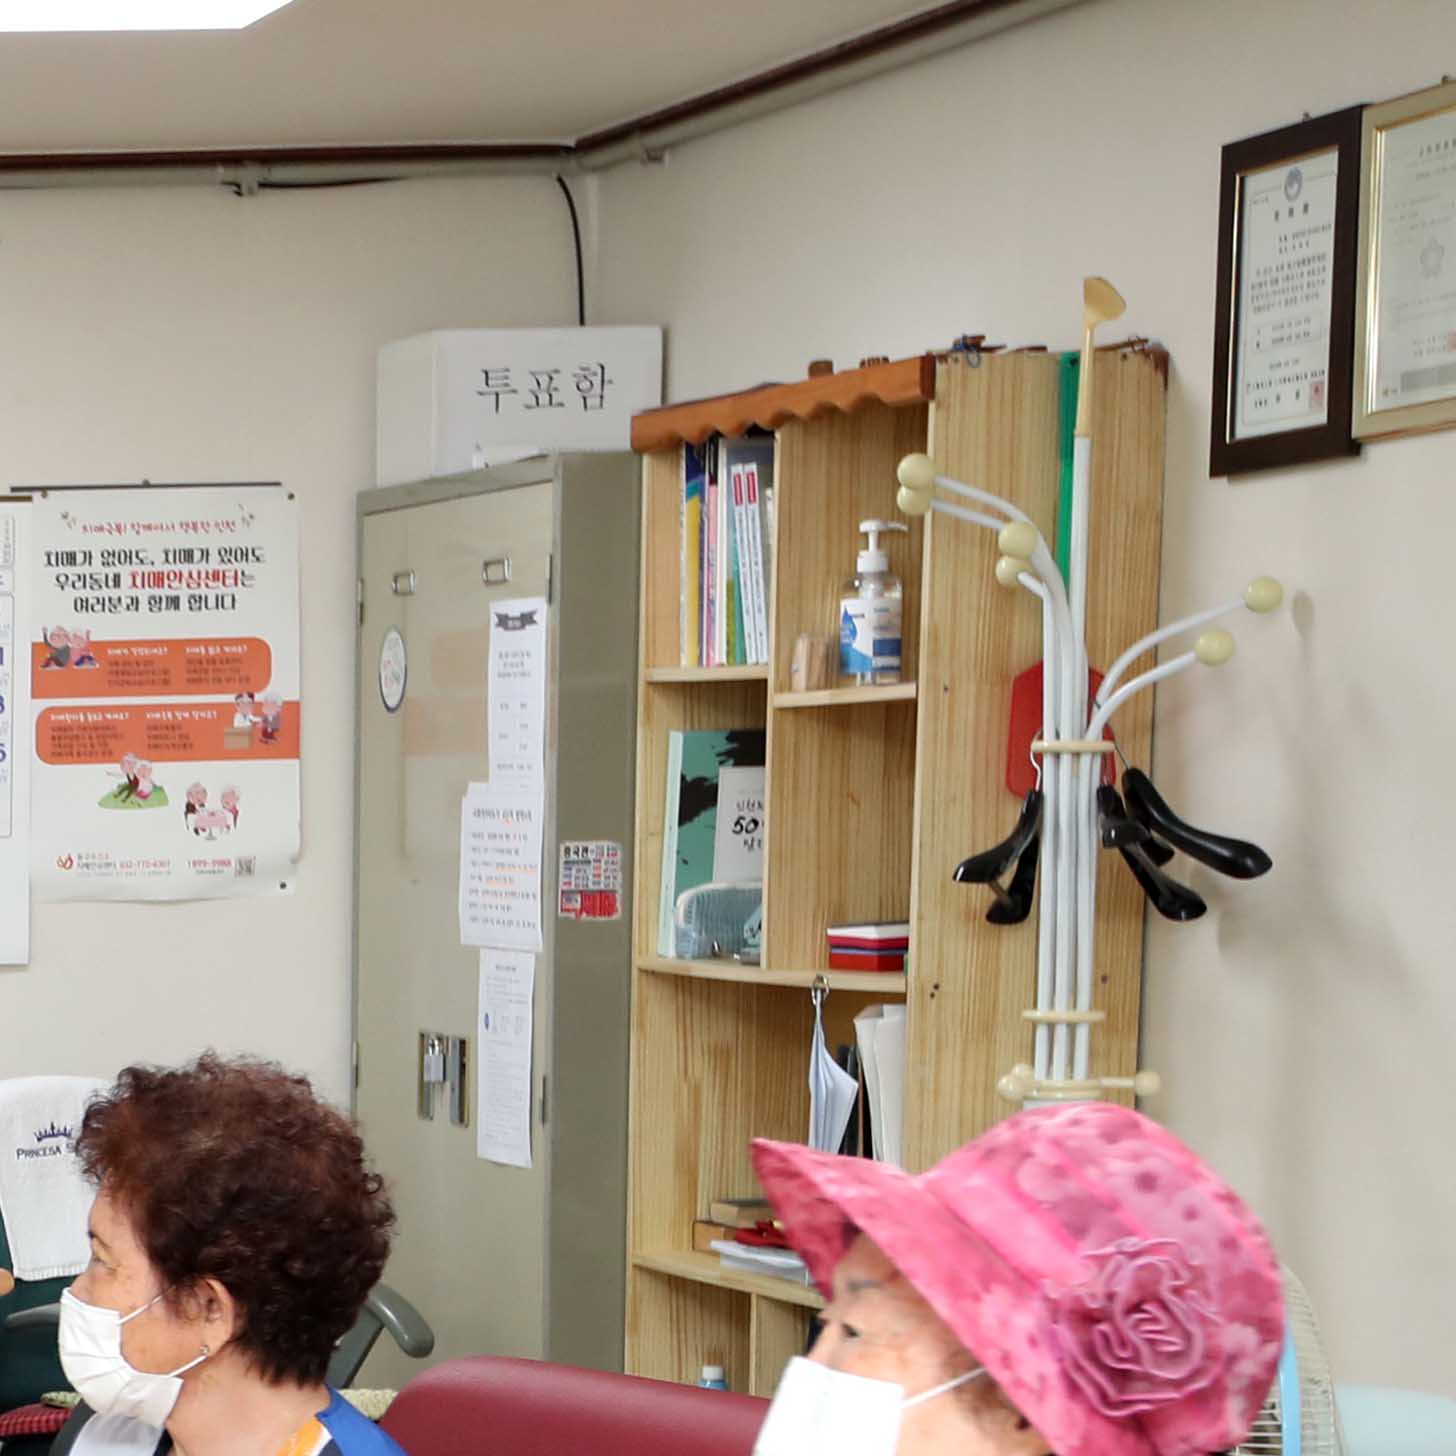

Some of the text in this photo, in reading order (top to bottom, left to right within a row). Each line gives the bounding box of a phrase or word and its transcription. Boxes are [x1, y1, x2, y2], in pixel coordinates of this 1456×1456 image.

[476, 361, 613, 414] 투표함
[44, 551, 92, 567] 치매가
[162, 548, 209, 566] 치매가
[218, 546, 265, 565] 있어도
[55, 569, 255, 591] 우리동네 치매안심센터는
[73, 593, 236, 614] 여러분과 함께 합니다
